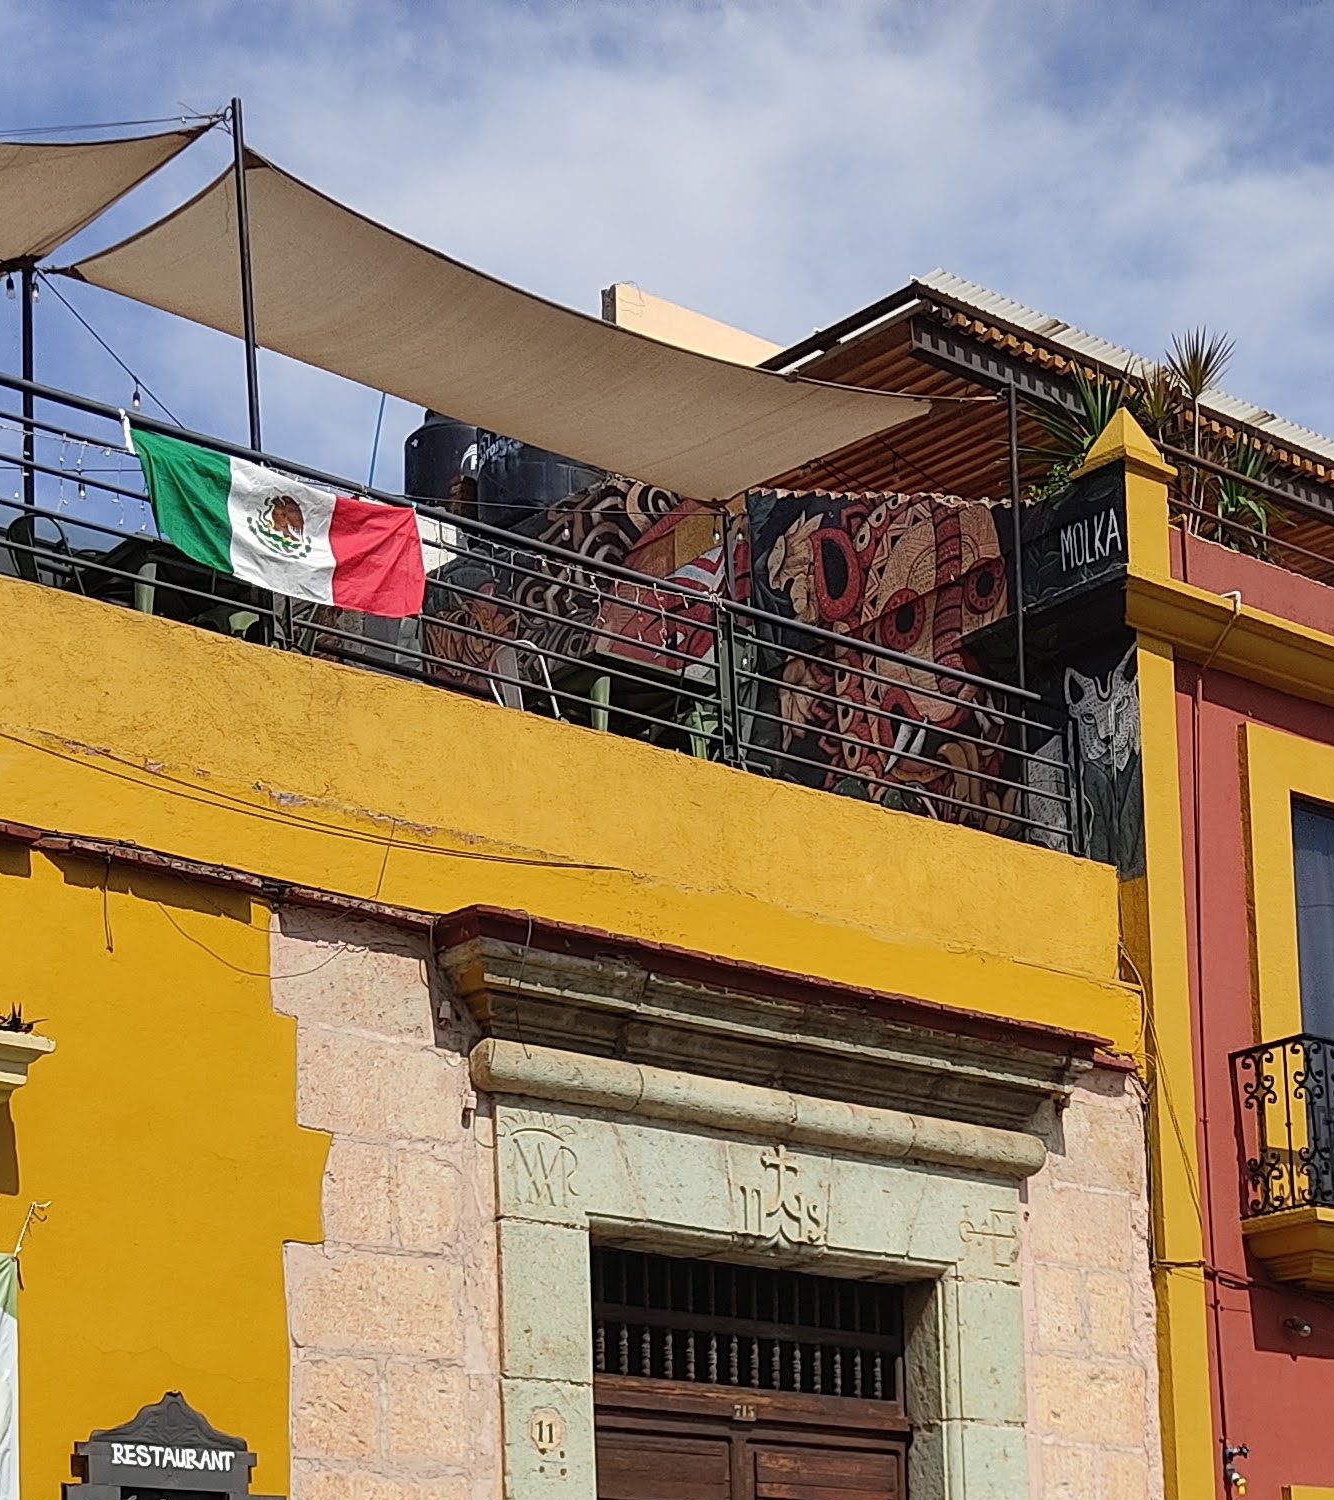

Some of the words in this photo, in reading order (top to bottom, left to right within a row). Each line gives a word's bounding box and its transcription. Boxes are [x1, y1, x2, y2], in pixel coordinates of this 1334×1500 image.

[1060, 508, 1122, 572] MOLKA
[535, 1420, 555, 1443] 11
[111, 1443, 235, 1471] RESTAURANT
